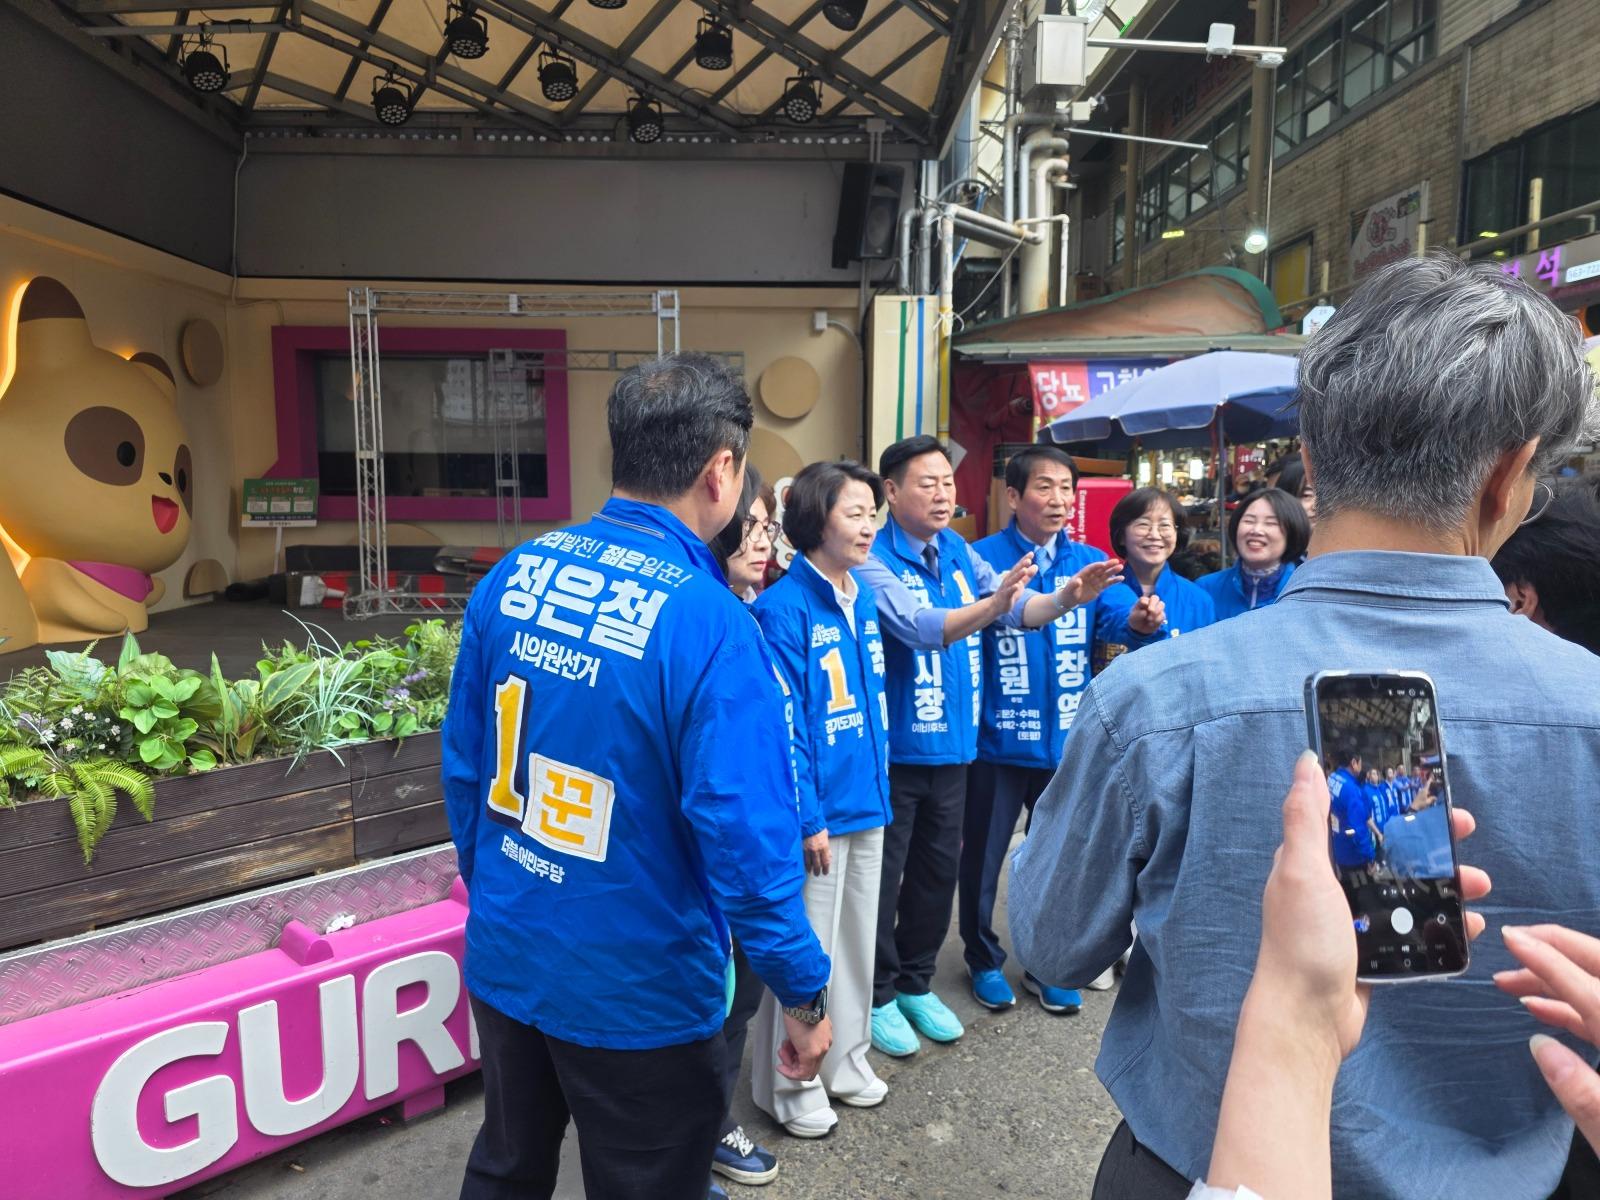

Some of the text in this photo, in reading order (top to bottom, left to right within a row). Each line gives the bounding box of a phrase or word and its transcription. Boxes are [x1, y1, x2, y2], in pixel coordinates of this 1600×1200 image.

[1037, 370, 1085, 410] 당뇨
[598, 544, 693, 588] 젊은일꾼!
[952, 569, 975, 604] 1
[500, 554, 669, 660] 정은철
[510, 631, 601, 688] 시의원선거
[819, 647, 856, 714] 1
[912, 722, 949, 733] 예비후보
[487, 674, 594, 845] 1 꾼
[501, 835, 565, 884] 더불어민주당
[91, 951, 481, 1187] GUR
